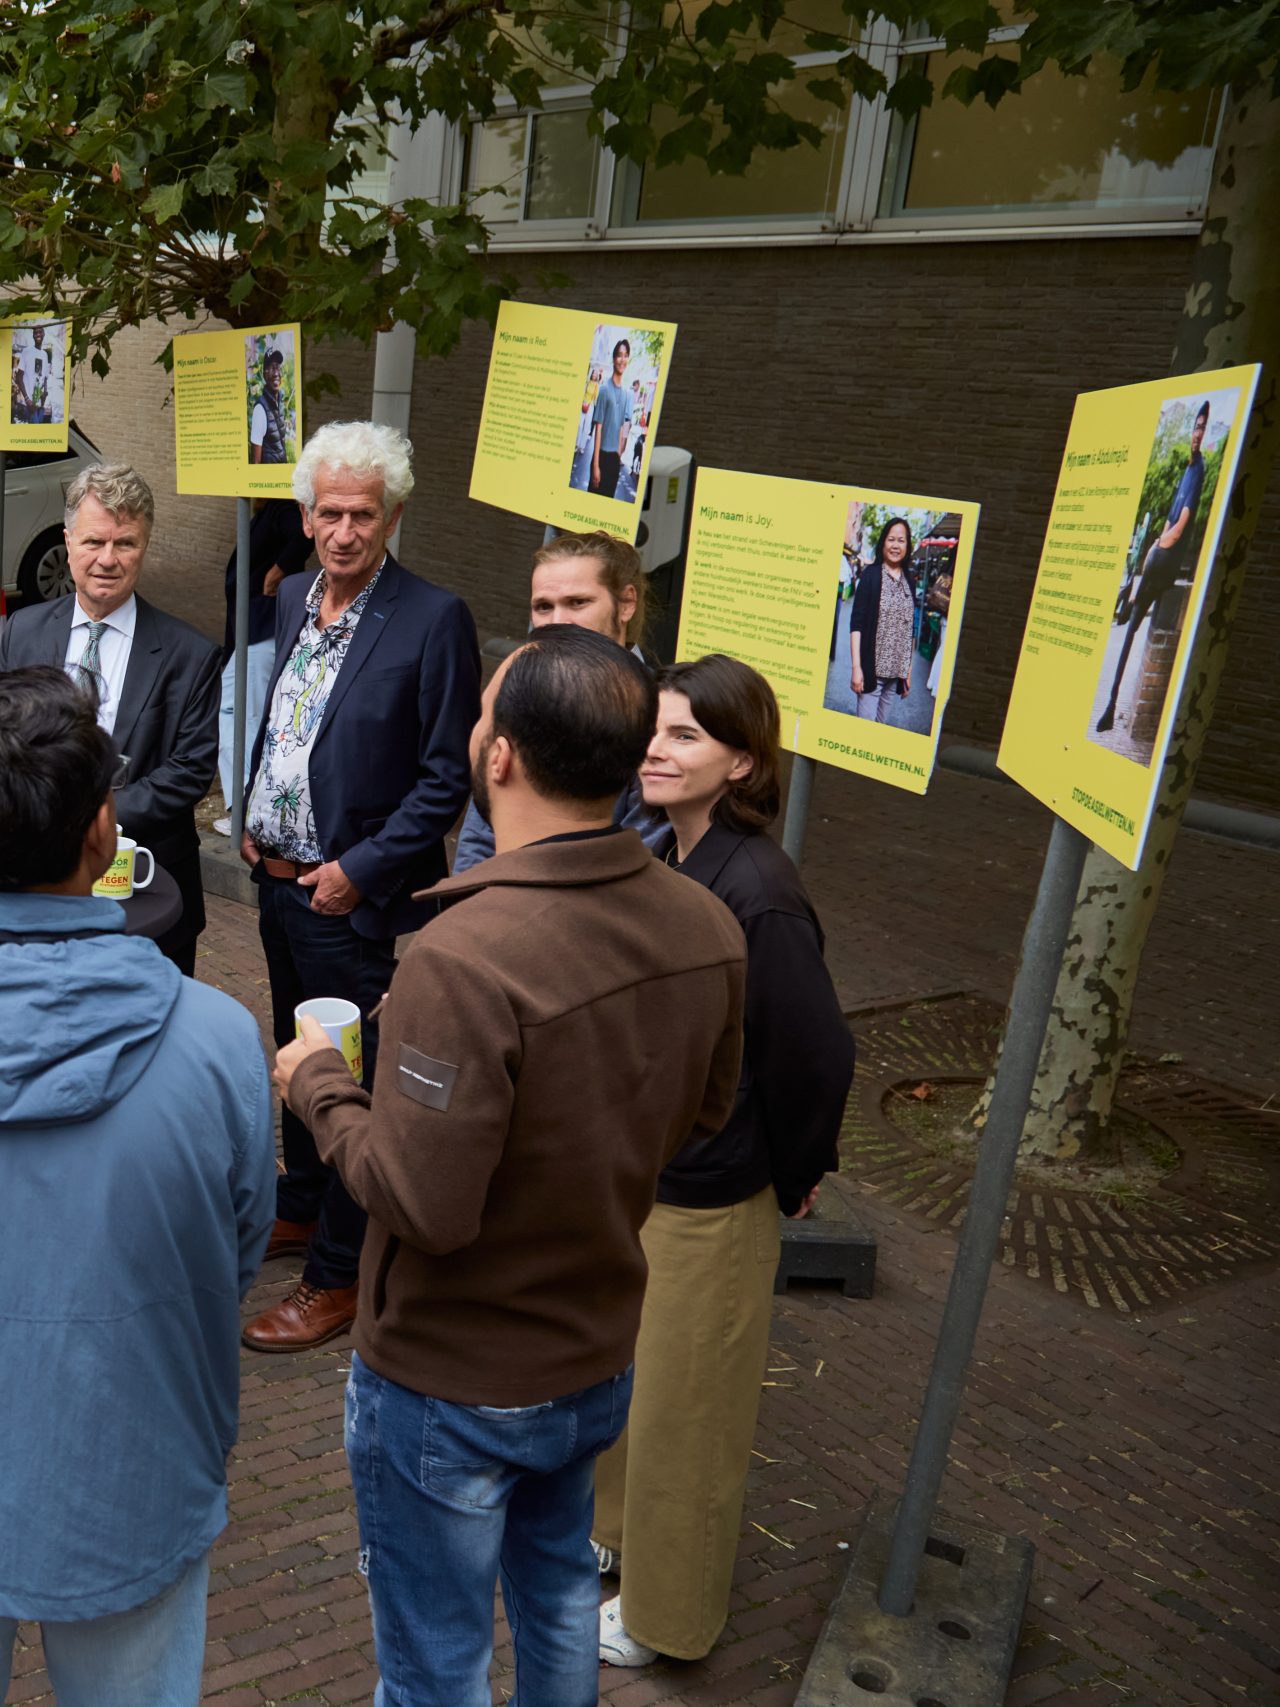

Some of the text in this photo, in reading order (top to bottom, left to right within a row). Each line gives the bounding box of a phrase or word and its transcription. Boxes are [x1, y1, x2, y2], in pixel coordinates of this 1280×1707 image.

[499, 331, 512, 344] Mijn
[513, 335, 528, 344] naam
[529, 336, 534, 345] is
[563, 510, 630, 536] STOPDEASIELWETTEN.NL
[700, 505, 774, 529] Mijn naam is Joy.
[818, 737, 926, 777] STOPDEASIELWETTEN.NL
[101, 875, 129, 884] TEGEN
